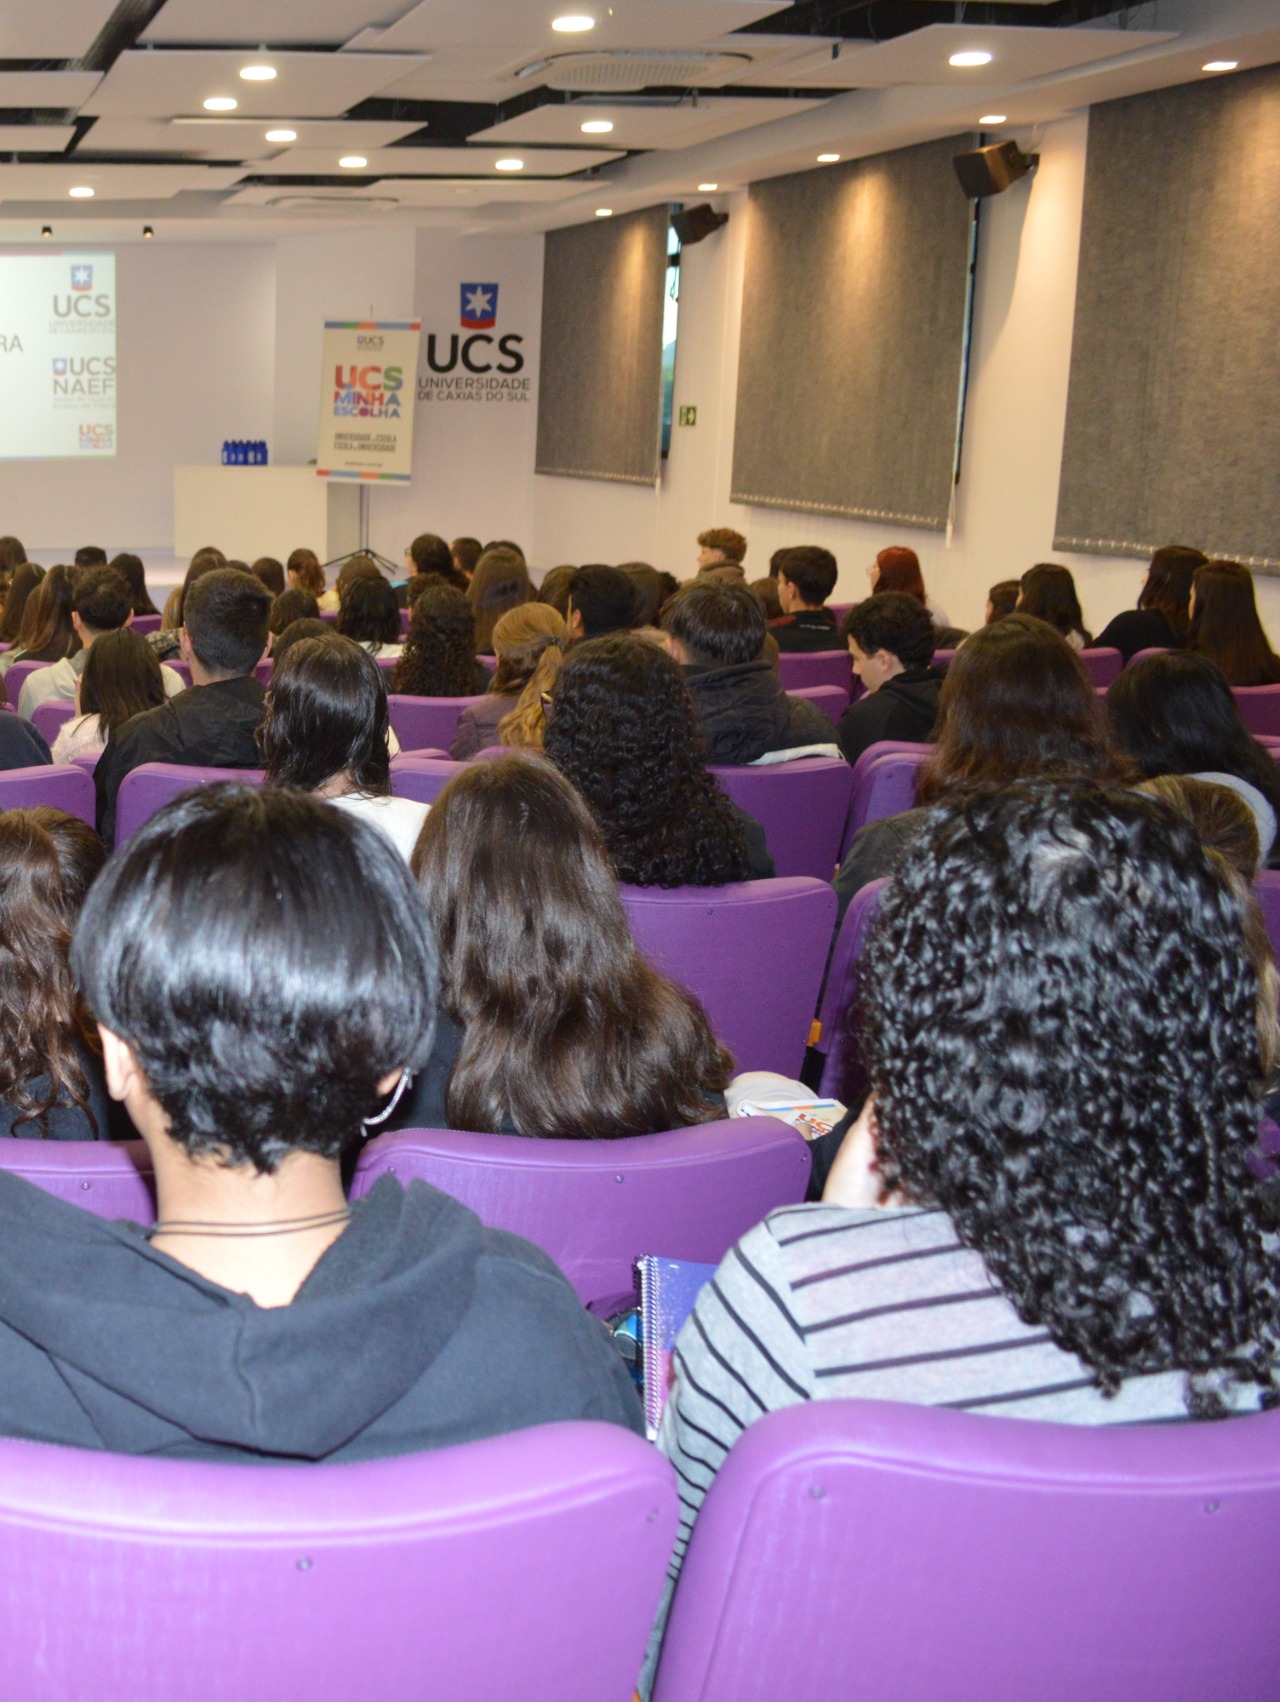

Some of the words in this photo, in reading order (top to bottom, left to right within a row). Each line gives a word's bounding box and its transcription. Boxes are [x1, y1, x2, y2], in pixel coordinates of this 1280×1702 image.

[53, 294, 111, 318] UCS
[427, 333, 524, 374] UCS
[70, 357, 116, 376] UCS
[53, 378, 115, 395] NAEF
[335, 365, 404, 391] UCS
[418, 377, 531, 390] UNIVERSIDADE
[334, 390, 402, 407] MINHA
[417, 391, 433, 402] DE
[437, 391, 482, 402] CAXIAS
[486, 391, 504, 402] DO
[507, 391, 530, 402] SUL
[333, 406, 400, 418] ESCOLHA
